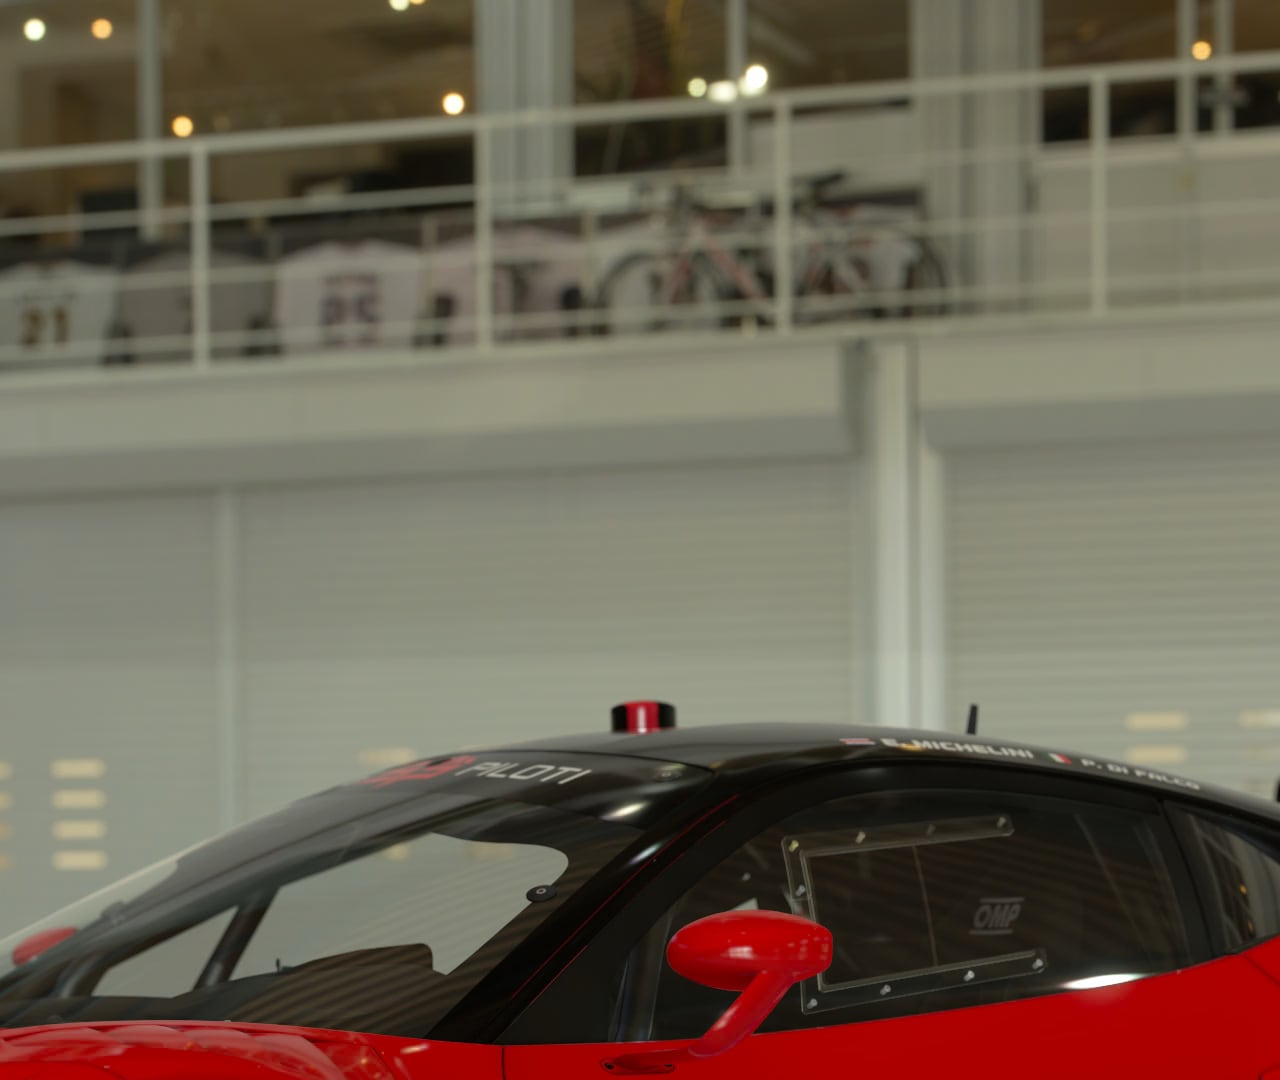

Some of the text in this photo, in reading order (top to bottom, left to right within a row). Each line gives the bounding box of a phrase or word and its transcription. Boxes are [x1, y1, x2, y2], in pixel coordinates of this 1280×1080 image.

[911, 738, 1034, 759] MICHELINI
[455, 762, 592, 785] PILOTI
[973, 902, 1021, 931] OMP
